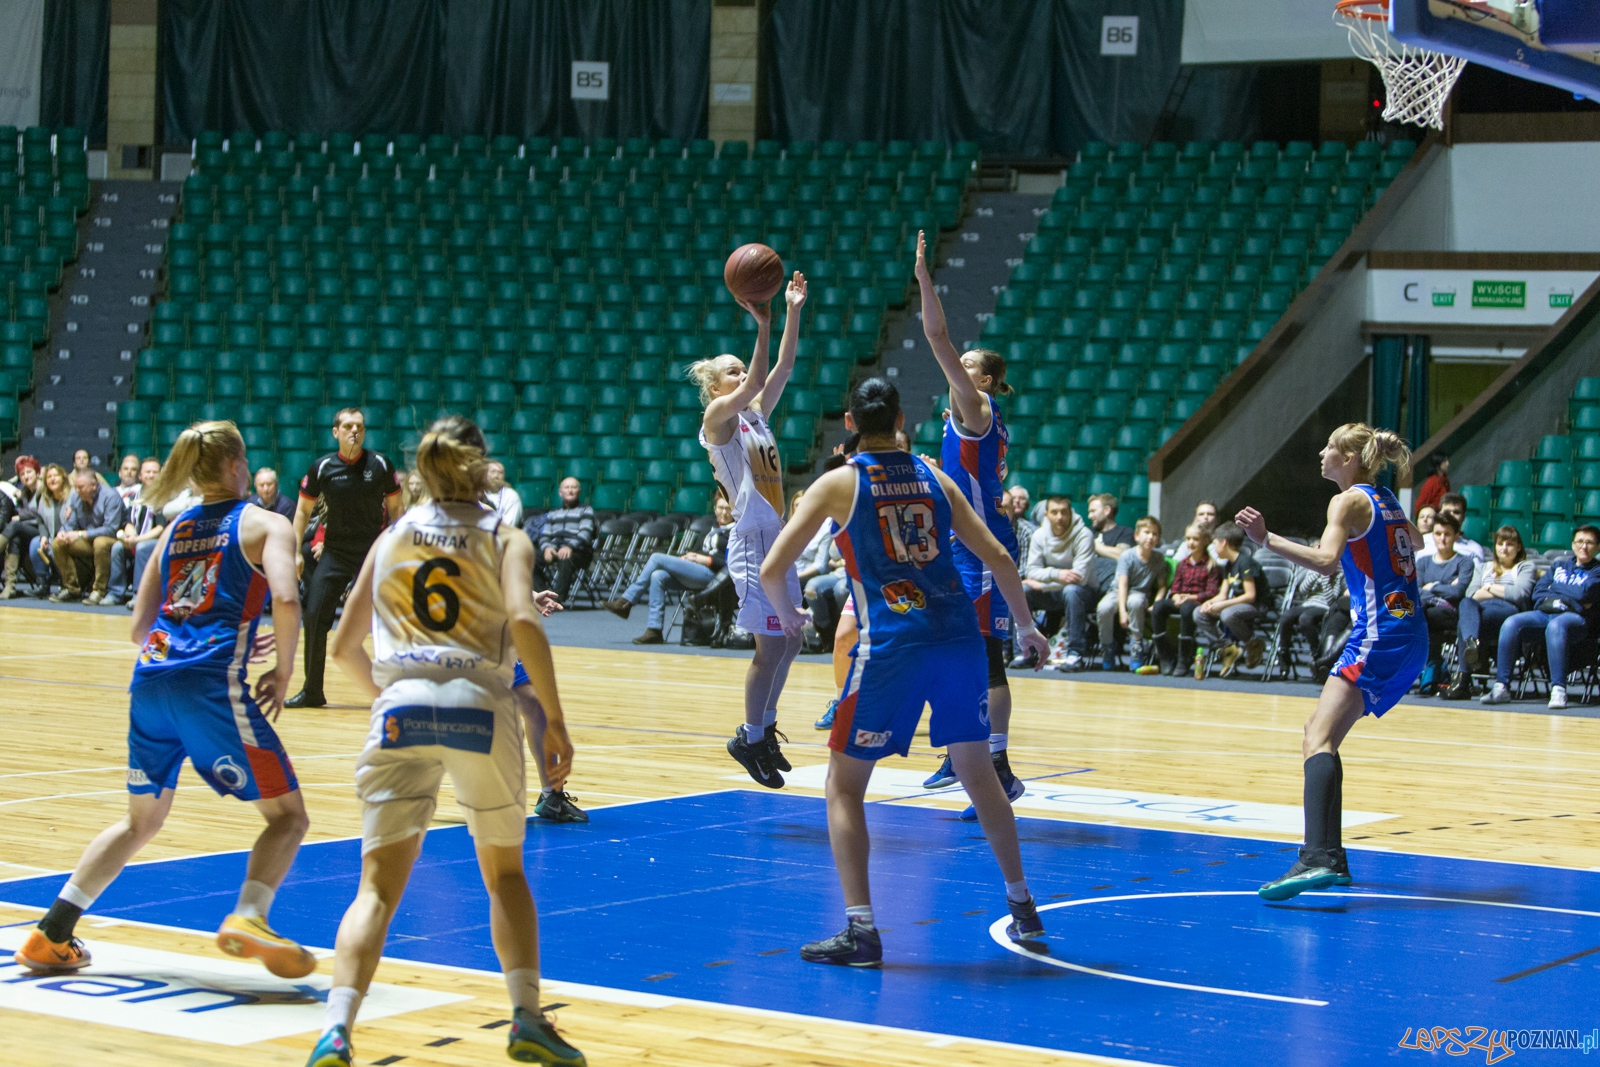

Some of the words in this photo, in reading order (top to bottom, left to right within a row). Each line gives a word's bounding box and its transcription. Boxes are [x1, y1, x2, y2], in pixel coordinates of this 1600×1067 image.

[1404, 282, 1418, 302] C
[1433, 293, 1453, 303] EXIT
[1550, 295, 1570, 304] EXIT
[51, 375, 61, 386] 7
[112, 376, 123, 387] 7
[886, 464, 926, 477] STRUS
[870, 481, 932, 497] OLKHOVIK
[413, 530, 469, 549] DURAK
[877, 502, 940, 563] 13
[413, 557, 461, 632] 6
